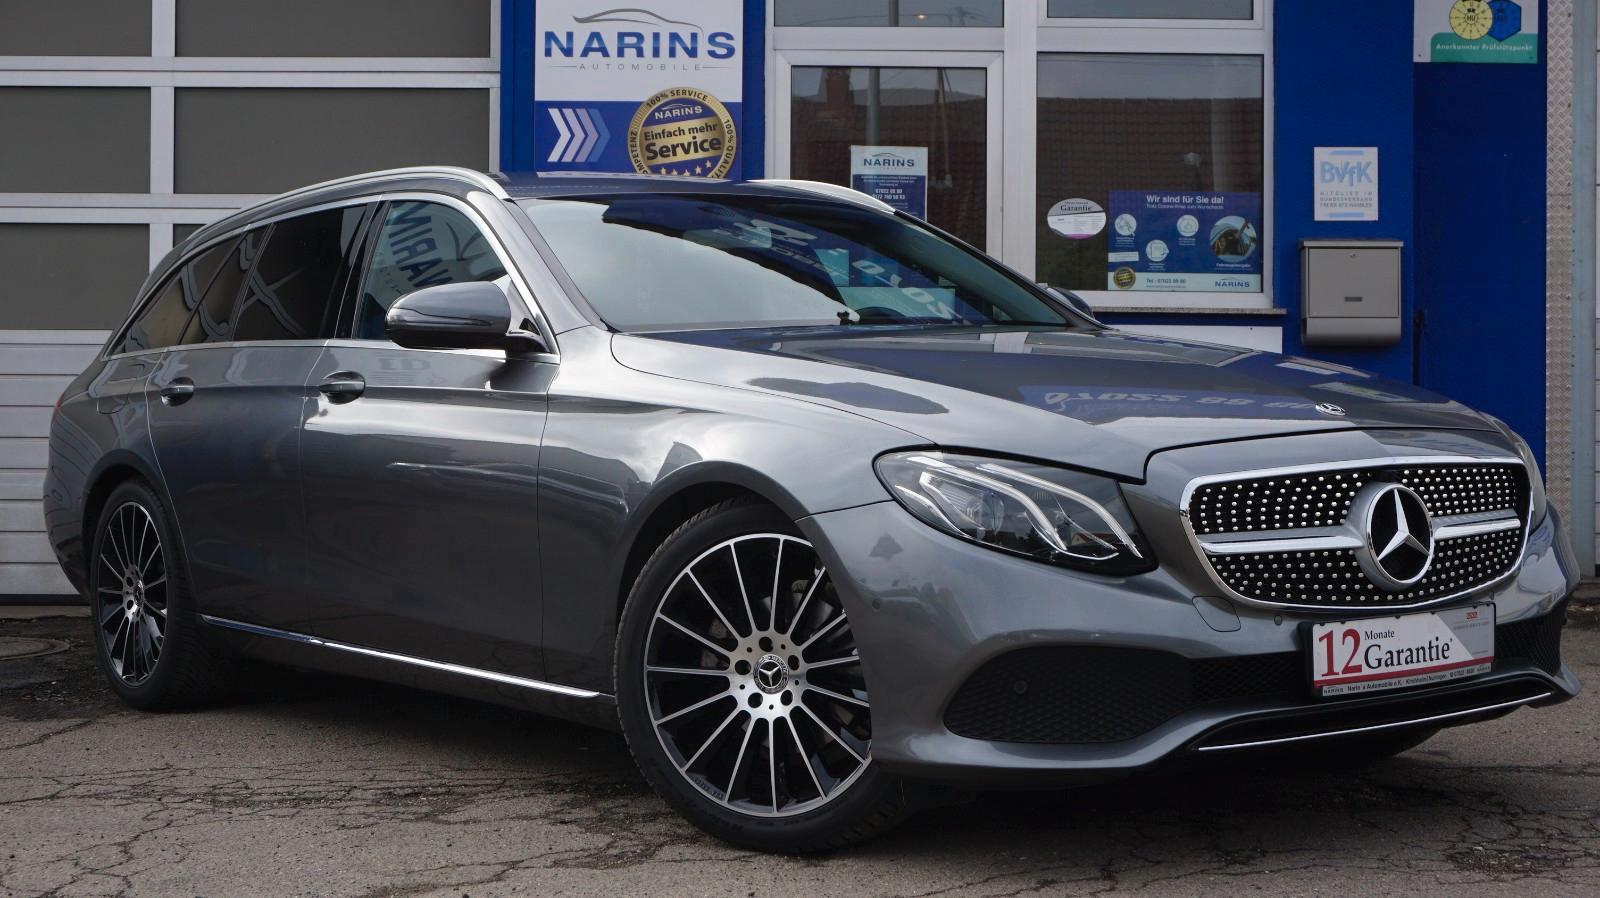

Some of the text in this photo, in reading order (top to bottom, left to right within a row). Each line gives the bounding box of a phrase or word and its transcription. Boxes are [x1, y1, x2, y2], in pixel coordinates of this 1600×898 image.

[544, 31, 736, 59] NARINS
[579, 63, 700, 71] AUTOMOBILE
[646, 89, 709, 109] 100% SERVICE
[655, 105, 703, 120] NARINS
[643, 122, 719, 142] Einfach mehr
[645, 135, 722, 161] Service
[711, 119, 735, 178] 100% QUALIT
[863, 158, 915, 167] NARINS
[1146, 195, 1224, 204] Wir sind für Sie da!
[1364, 629, 1395, 641] Monate
[1318, 628, 1363, 677] 12
